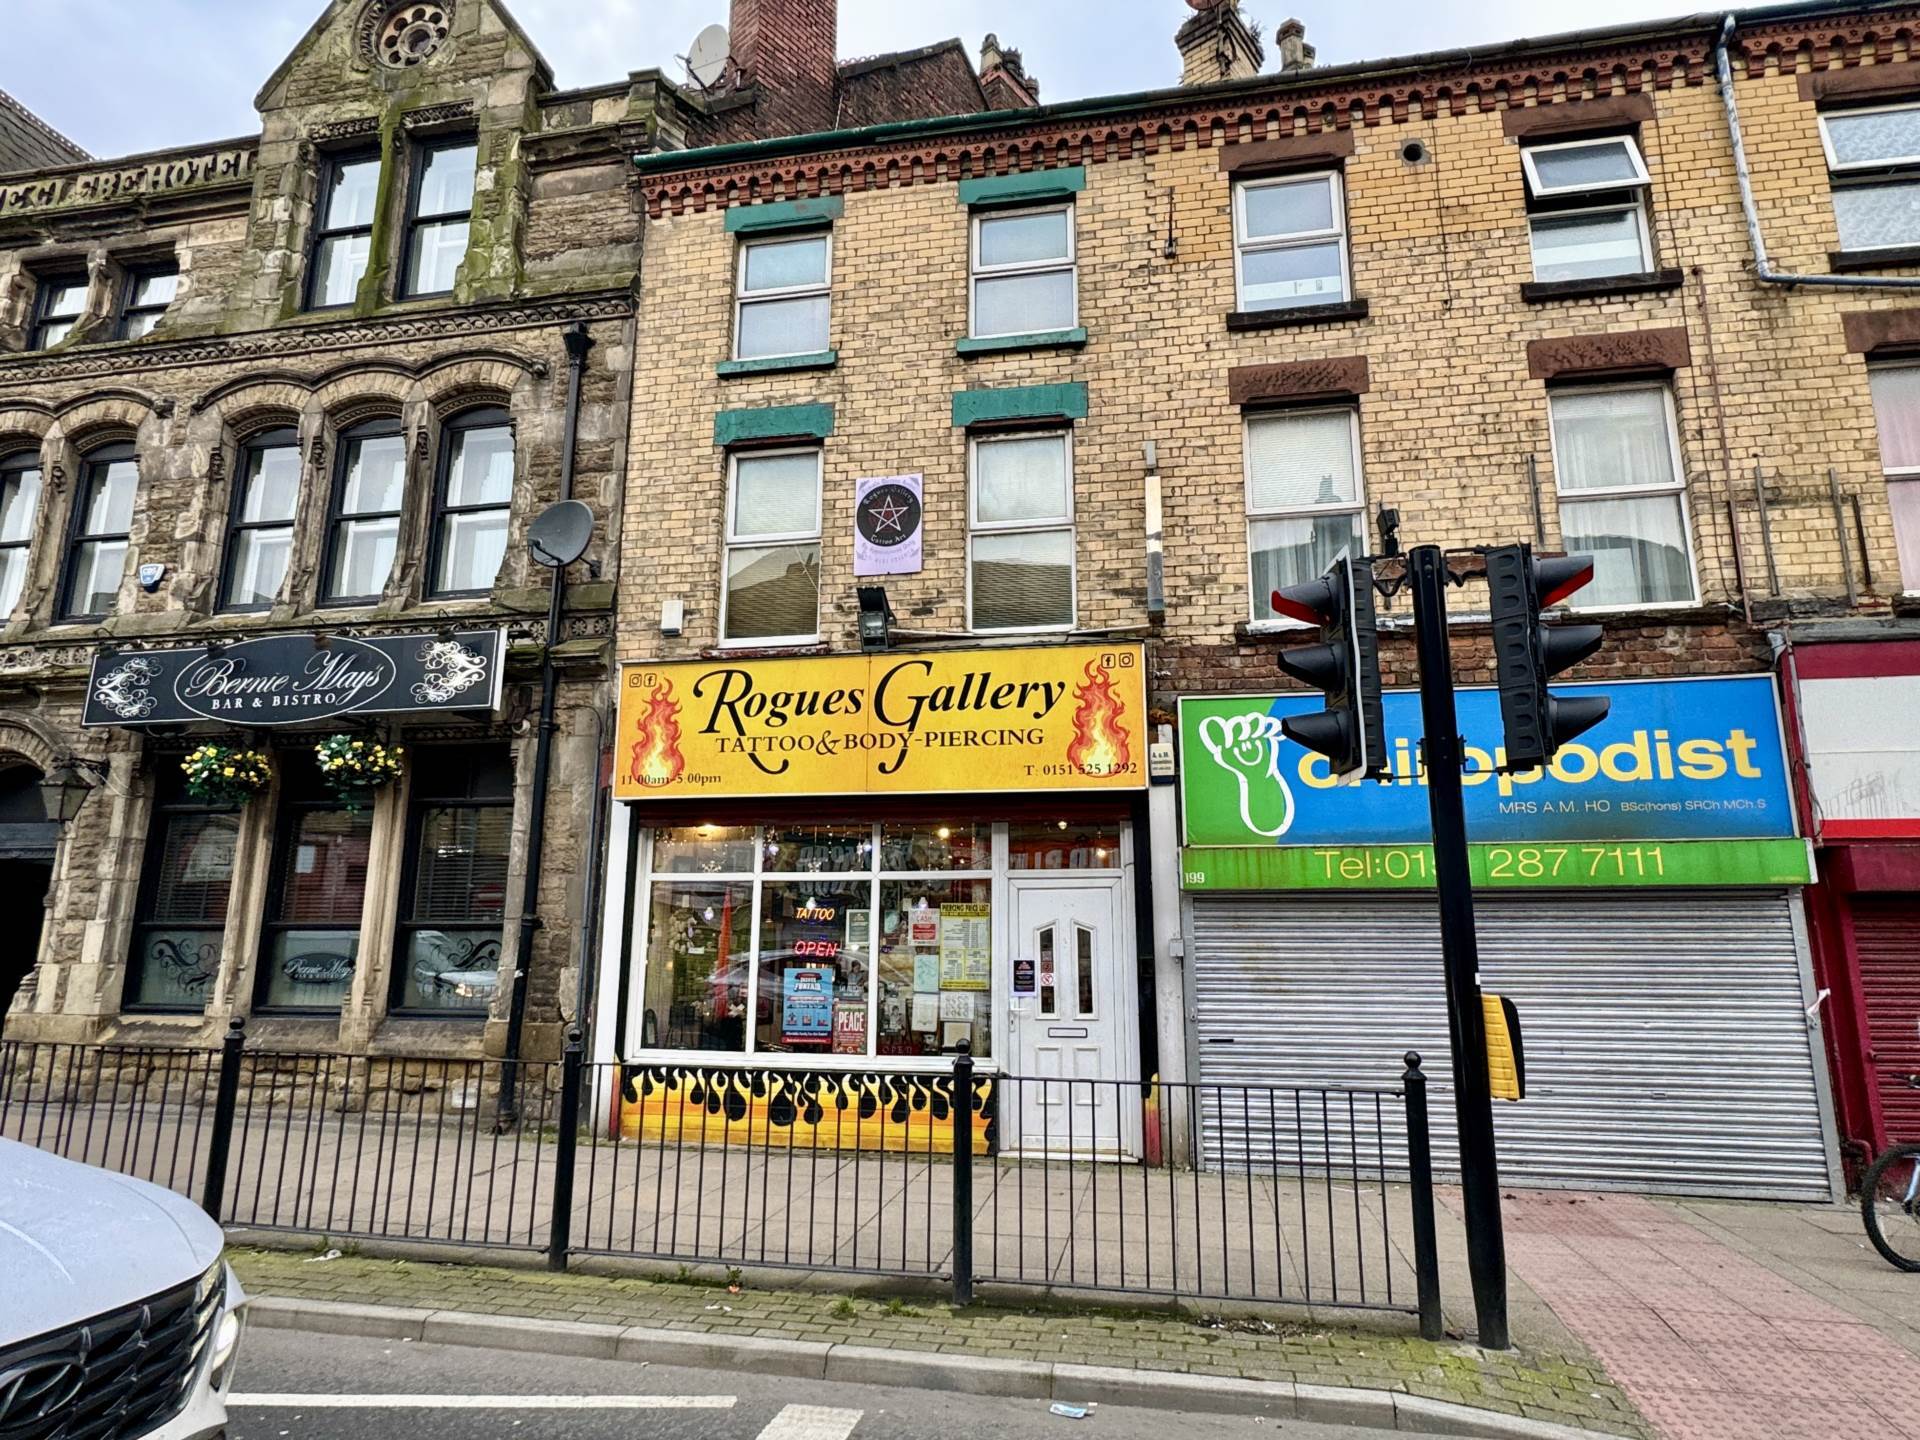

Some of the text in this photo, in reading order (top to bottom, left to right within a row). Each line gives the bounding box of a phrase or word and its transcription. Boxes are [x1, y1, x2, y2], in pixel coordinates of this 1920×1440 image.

[185, 650, 385, 706] Bernie May's
[211, 693, 337, 710] BAR & BISTRO
[693, 660, 1066, 774] Rogues Gallery
[1043, 764, 1073, 776] 0151
[1078, 763, 1102, 775] 525
[1107, 762, 1137, 774] 1292
[1298, 729, 1762, 796] ciopodist
[1500, 802, 1537, 814] MRS
[1542, 801, 1579, 813] A.M.
[1585, 800, 1611, 813] HO
[1620, 801, 1681, 812] BSc(hons)
[1315, 847, 1664, 880] Tel:01 287 7111
[1185, 871, 1206, 884] 199
[796, 907, 835, 920] TATTOO
[794, 940, 838, 957] OPEN
[838, 1011, 865, 1032] PEACE
[882, 1045, 912, 1054] OPEN
